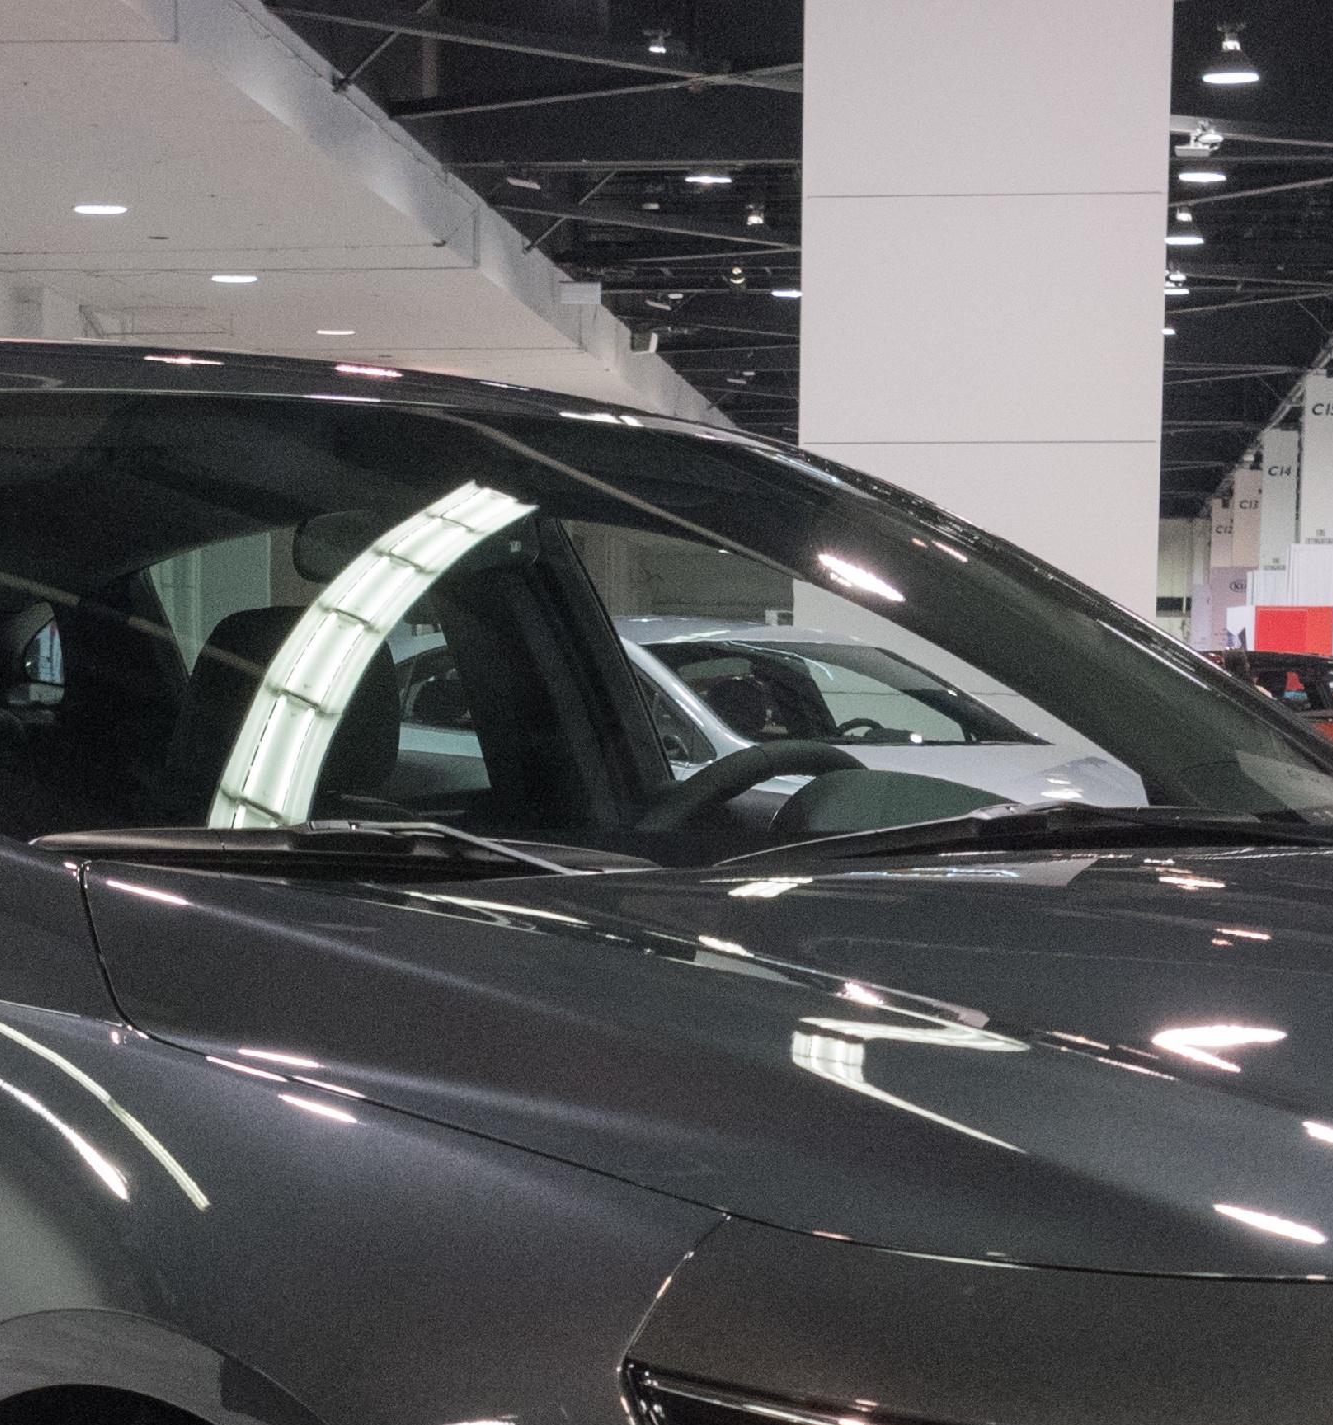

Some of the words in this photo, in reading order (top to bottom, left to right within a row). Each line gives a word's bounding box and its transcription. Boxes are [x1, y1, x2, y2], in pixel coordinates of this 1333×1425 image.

[1267, 466, 1292, 477] C14
[1239, 500, 1259, 509] C13
[1215, 525, 1234, 535] C12
